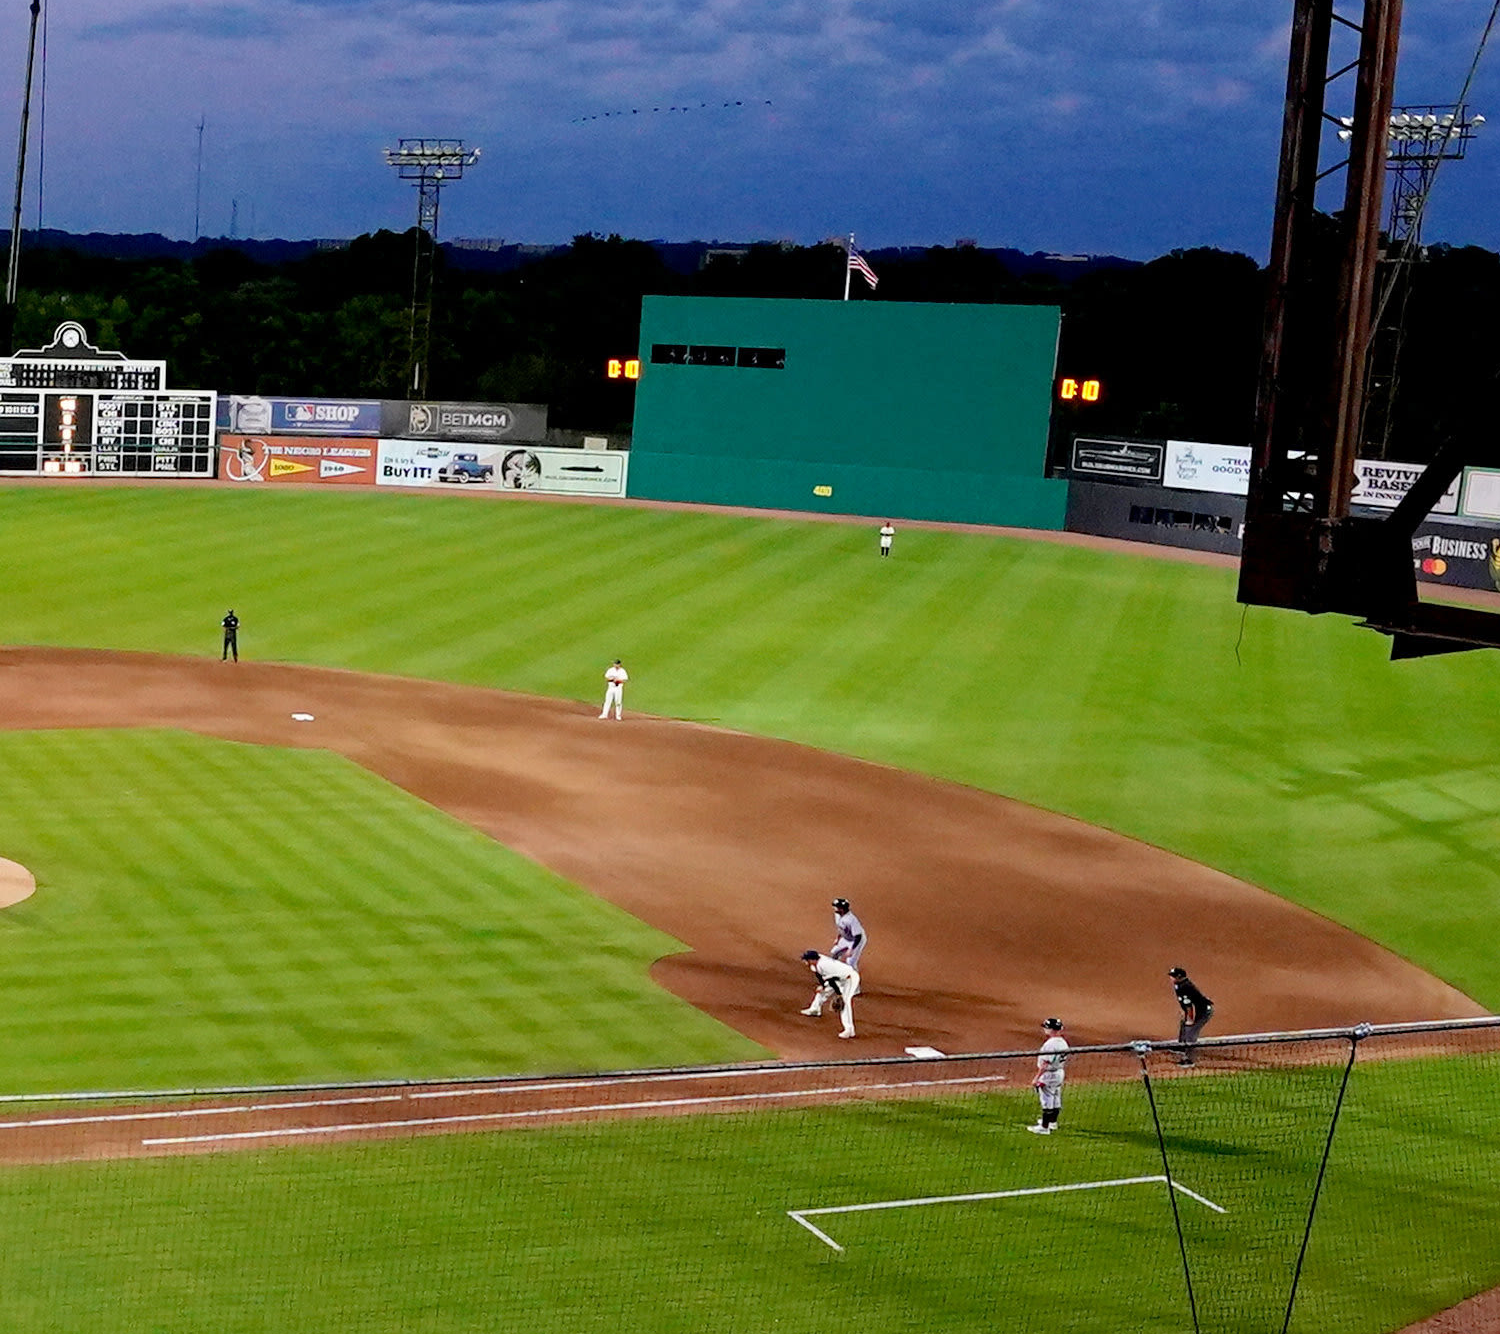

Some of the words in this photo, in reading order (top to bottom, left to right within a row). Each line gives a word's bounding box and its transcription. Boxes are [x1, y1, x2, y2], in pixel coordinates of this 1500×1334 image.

[608, 359, 639, 379] 0:10
[1061, 378, 1100, 402] 0:10
[315, 406, 360, 422] SHOP
[442, 413, 506, 427] BETMGM
[284, 447, 321, 455] NEGRO
[322, 447, 371, 457] LEAGUES
[384, 466, 411, 478] BUY
[413, 467, 432, 479] IT!
[1212, 465, 1242, 475] GOOD
[1362, 467, 1420, 481] REVIVI
[1432, 536, 1488, 560] BUSINESS
